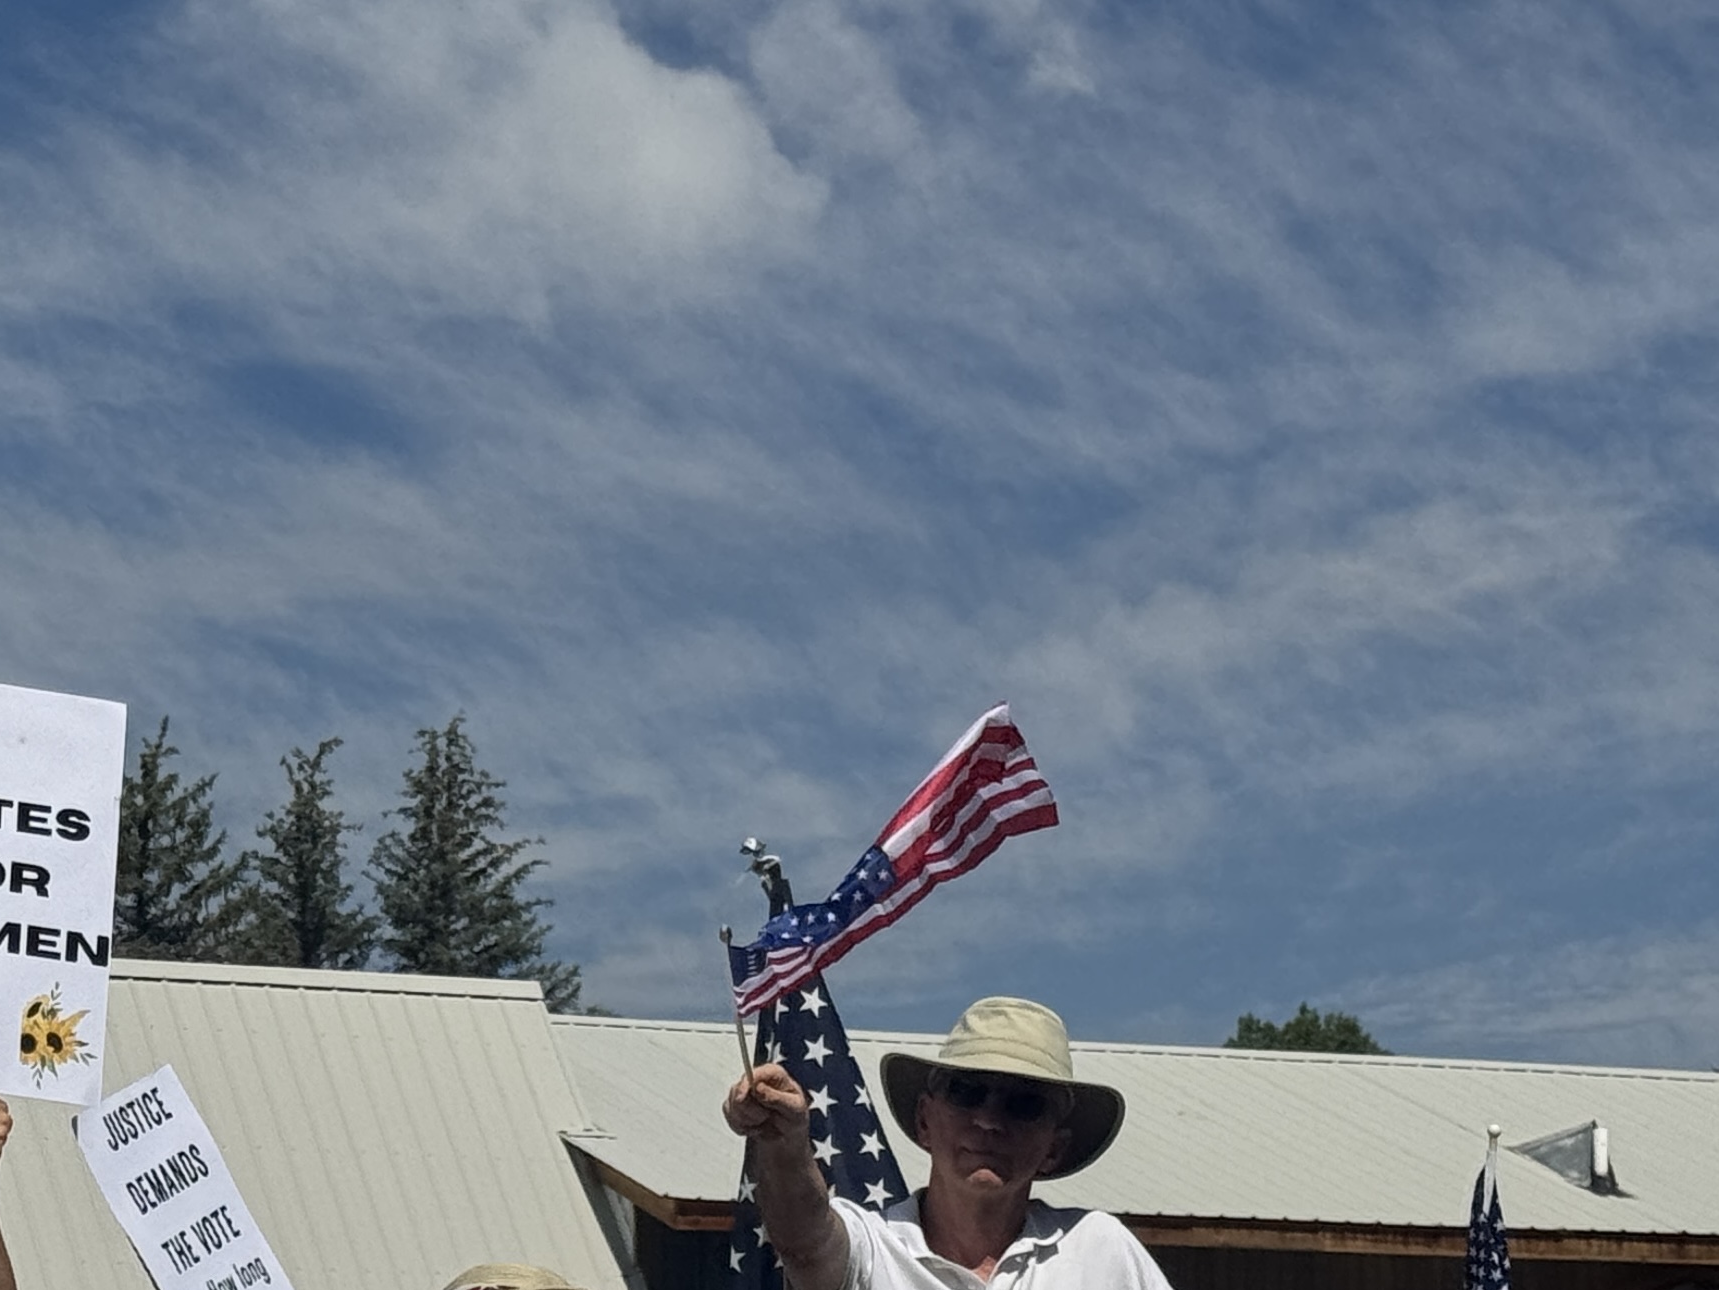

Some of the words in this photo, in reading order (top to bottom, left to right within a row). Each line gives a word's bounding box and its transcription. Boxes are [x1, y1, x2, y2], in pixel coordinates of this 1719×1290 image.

[102, 1087, 174, 1152] JUSTICE
[125, 1143, 210, 1216] DEMANDS
[161, 1230, 201, 1275] THE
[195, 1205, 242, 1255] VOTE
[235, 1256, 272, 1286] long
